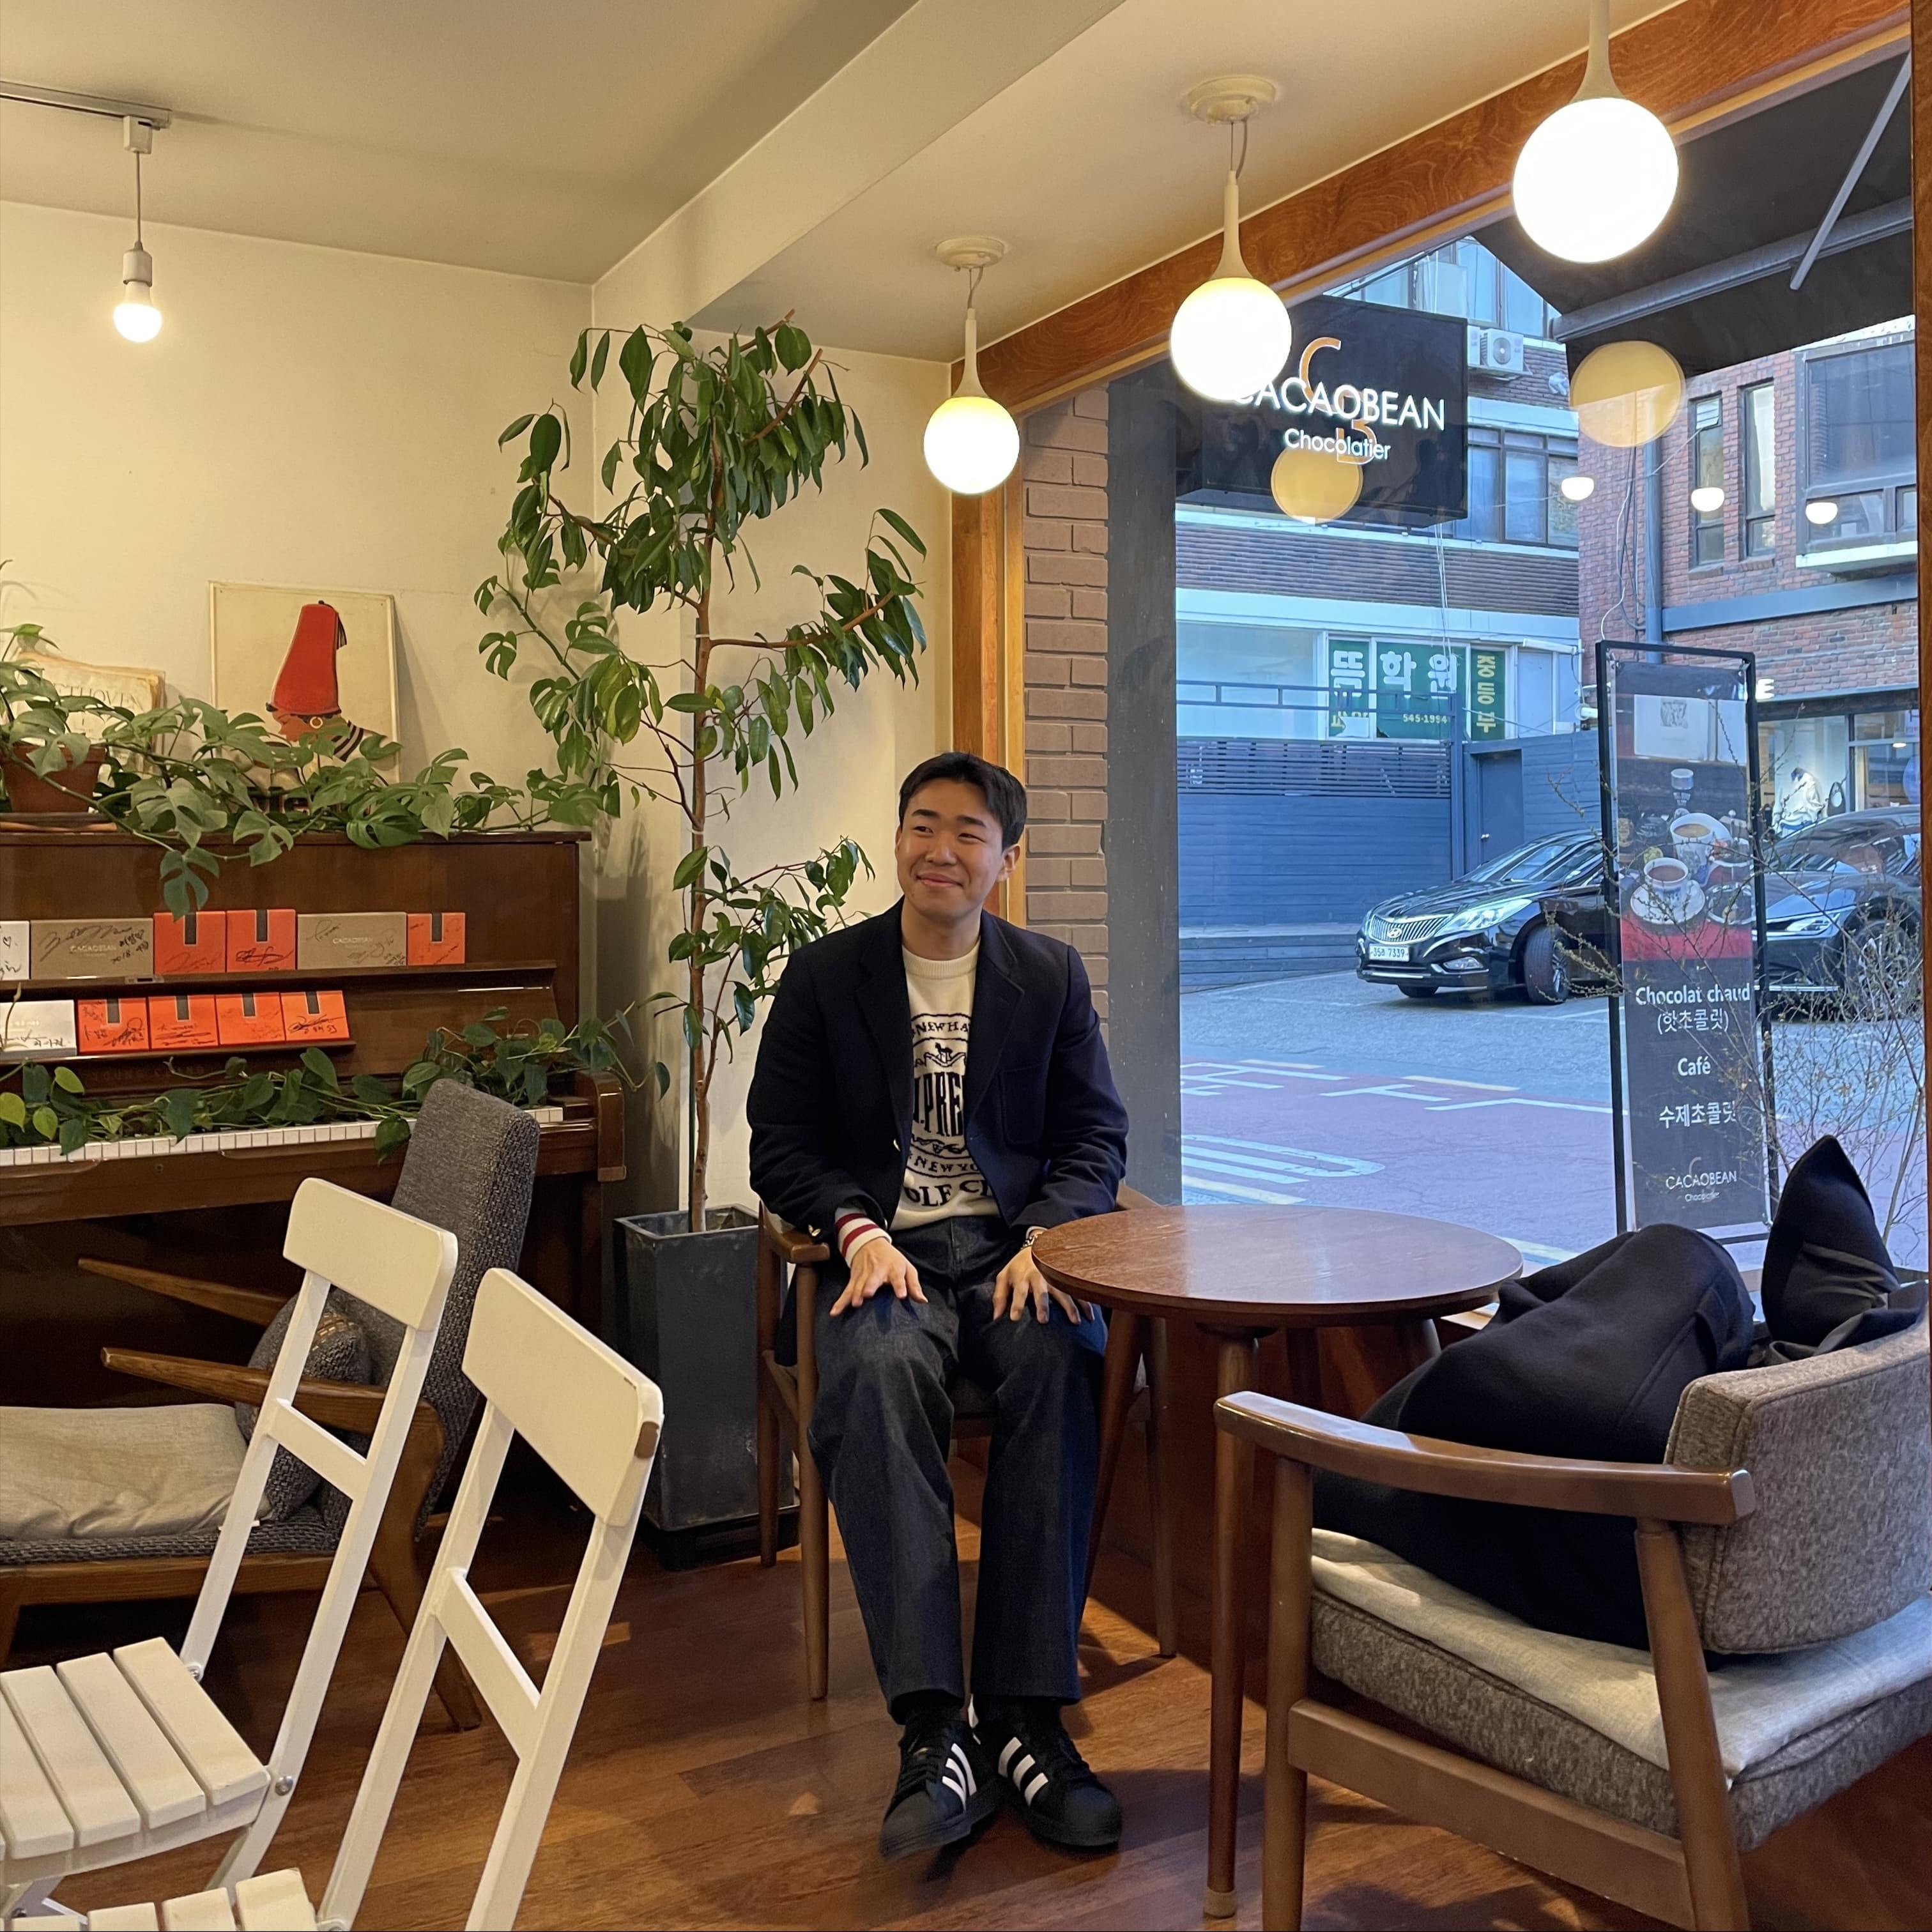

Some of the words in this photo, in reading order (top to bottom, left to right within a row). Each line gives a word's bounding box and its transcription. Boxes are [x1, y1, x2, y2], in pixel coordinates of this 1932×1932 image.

[1236, 376, 1445, 431] ACAOBEAN
[1284, 427, 1392, 461] Chocolatier
[1476, 655, 1496, 733] 중등부
[1636, 985, 1703, 1005] Chocolat
[1706, 983, 1751, 1002] chaud
[916, 1022, 945, 1036] NEW
[948, 1022, 970, 1032] HA
[1657, 1008, 1729, 1035] (핫초콜릿)
[1678, 1056, 1711, 1077] Café
[1659, 1100, 1736, 1129] 수제초콜릿
[914, 1156, 953, 1172] NEW
[1666, 1170, 1737, 1190] CACAOBEAN
